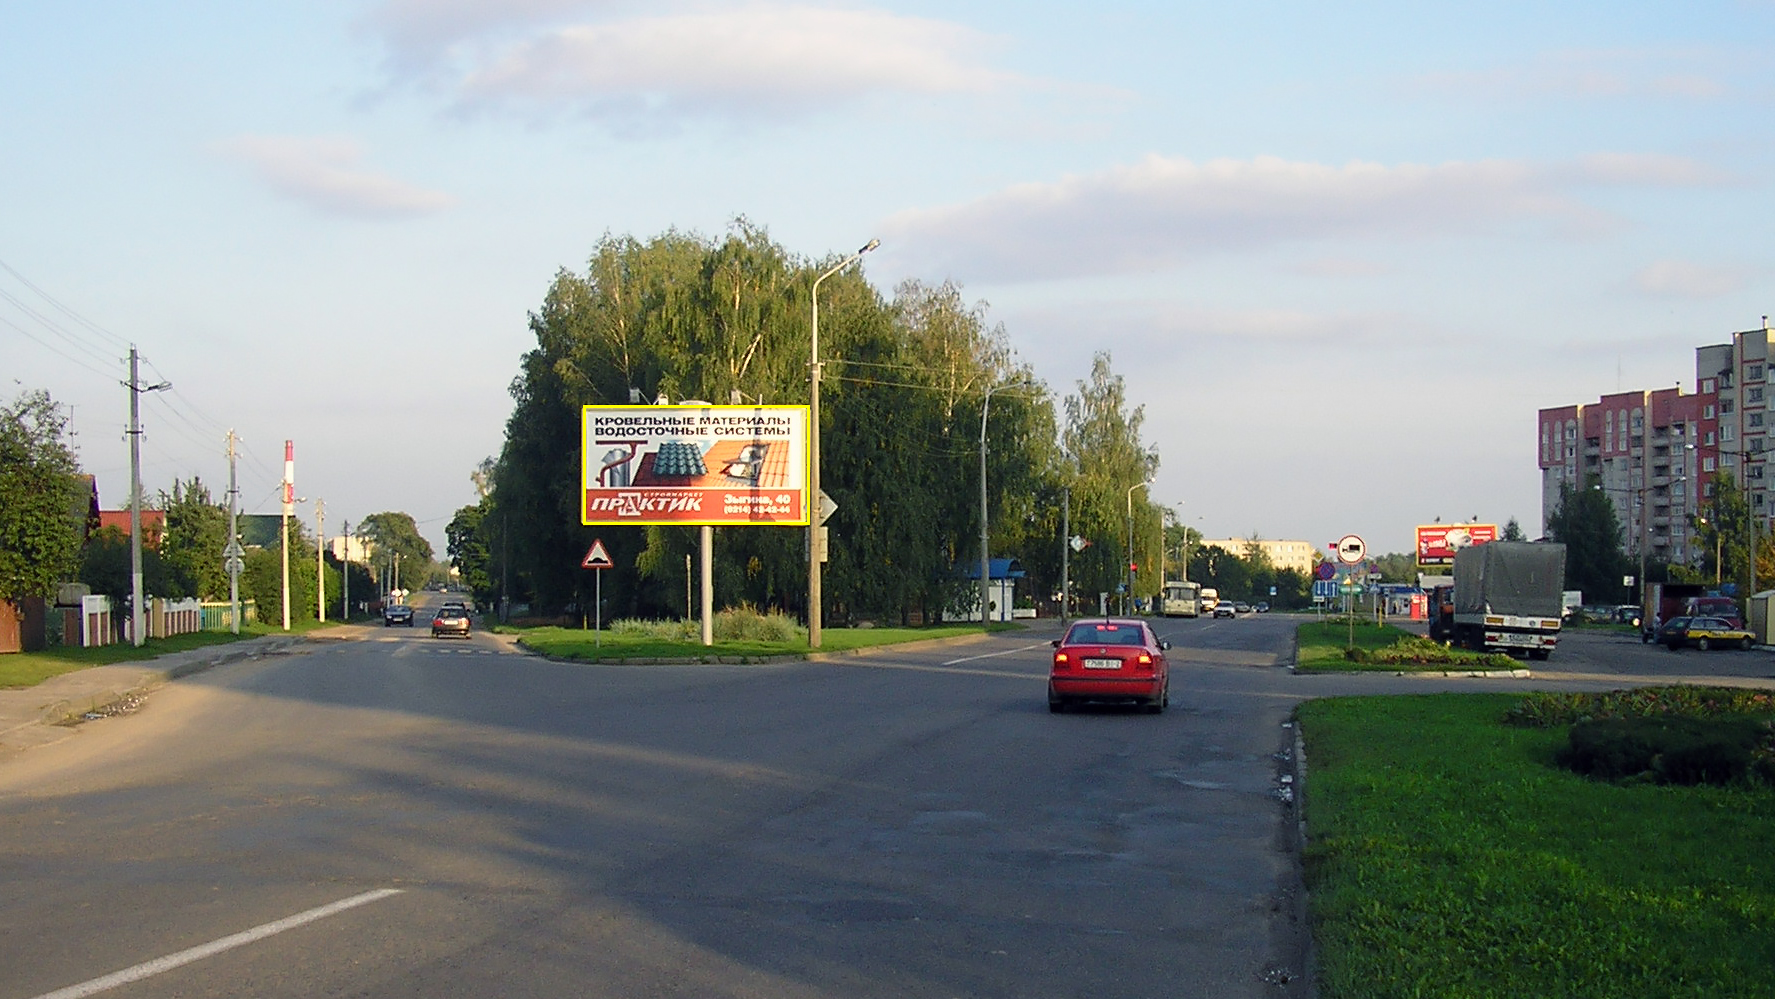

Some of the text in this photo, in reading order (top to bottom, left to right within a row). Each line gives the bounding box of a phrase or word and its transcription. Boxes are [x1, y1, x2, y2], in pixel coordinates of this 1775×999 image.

[595, 417, 791, 425] КРОВЕЛЬНЫЕ МАТЕРИАЛЫ
[595, 426, 791, 437] ВОДОСТОЧНЫЕ СИСТЕМЫ
[591, 492, 703, 516] ПРАКТИК
[775, 494, 791, 505] 40
[723, 505, 751, 514] (0214)
